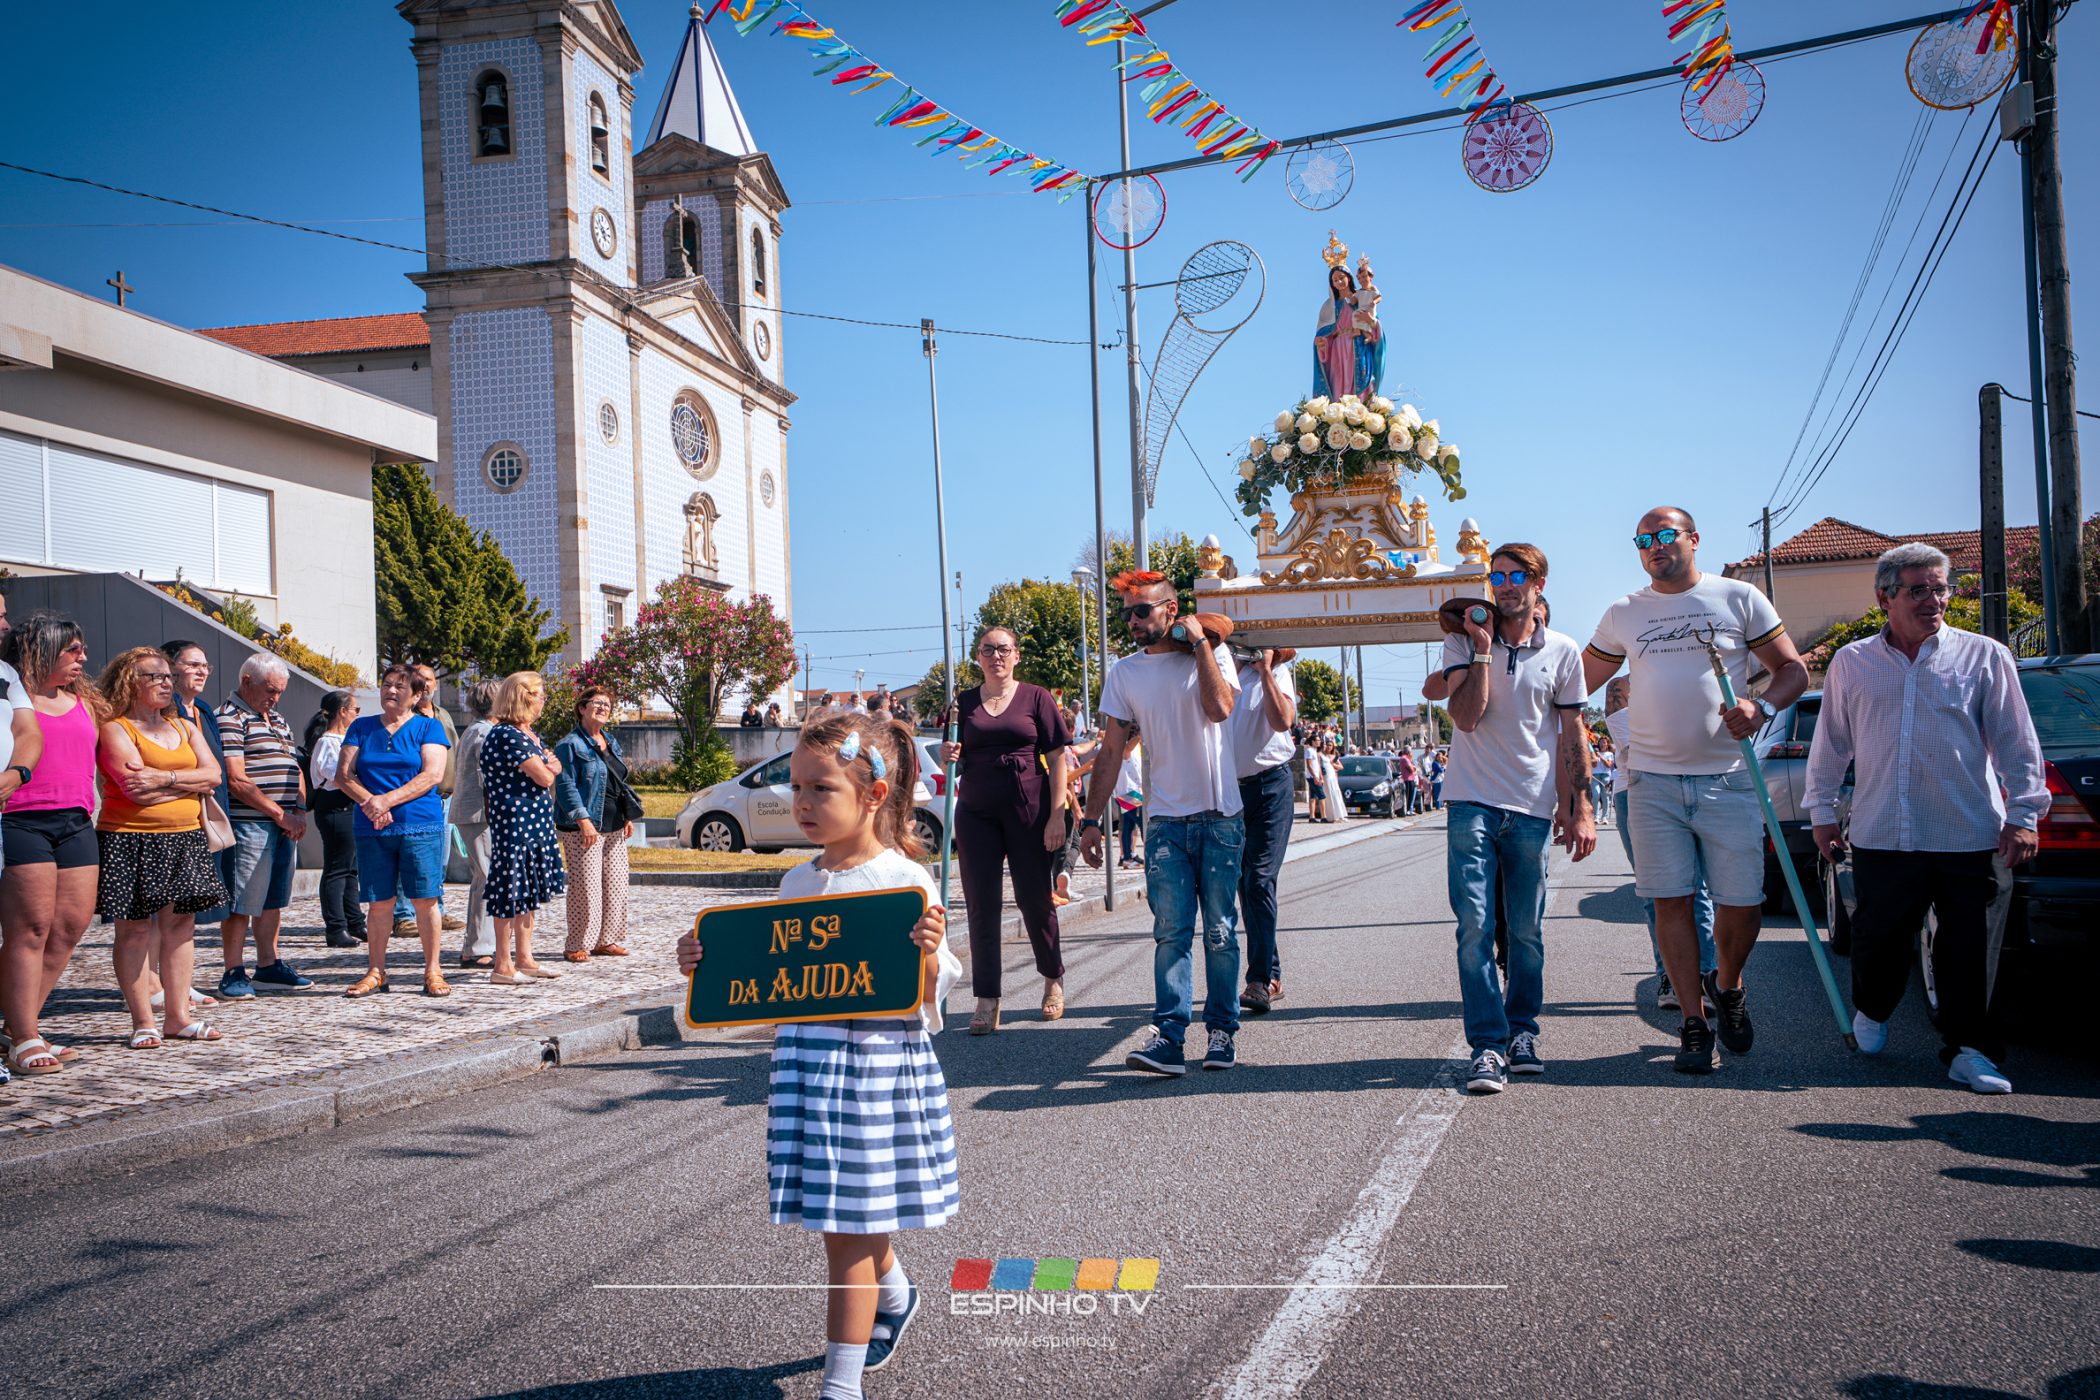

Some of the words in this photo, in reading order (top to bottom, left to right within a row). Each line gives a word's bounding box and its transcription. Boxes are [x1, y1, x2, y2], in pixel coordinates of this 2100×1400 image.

[757, 801, 779, 809] Escola
[757, 807, 791, 816] Condução
[728, 978, 760, 1006] DA
[767, 960, 876, 1002] AJUDA
